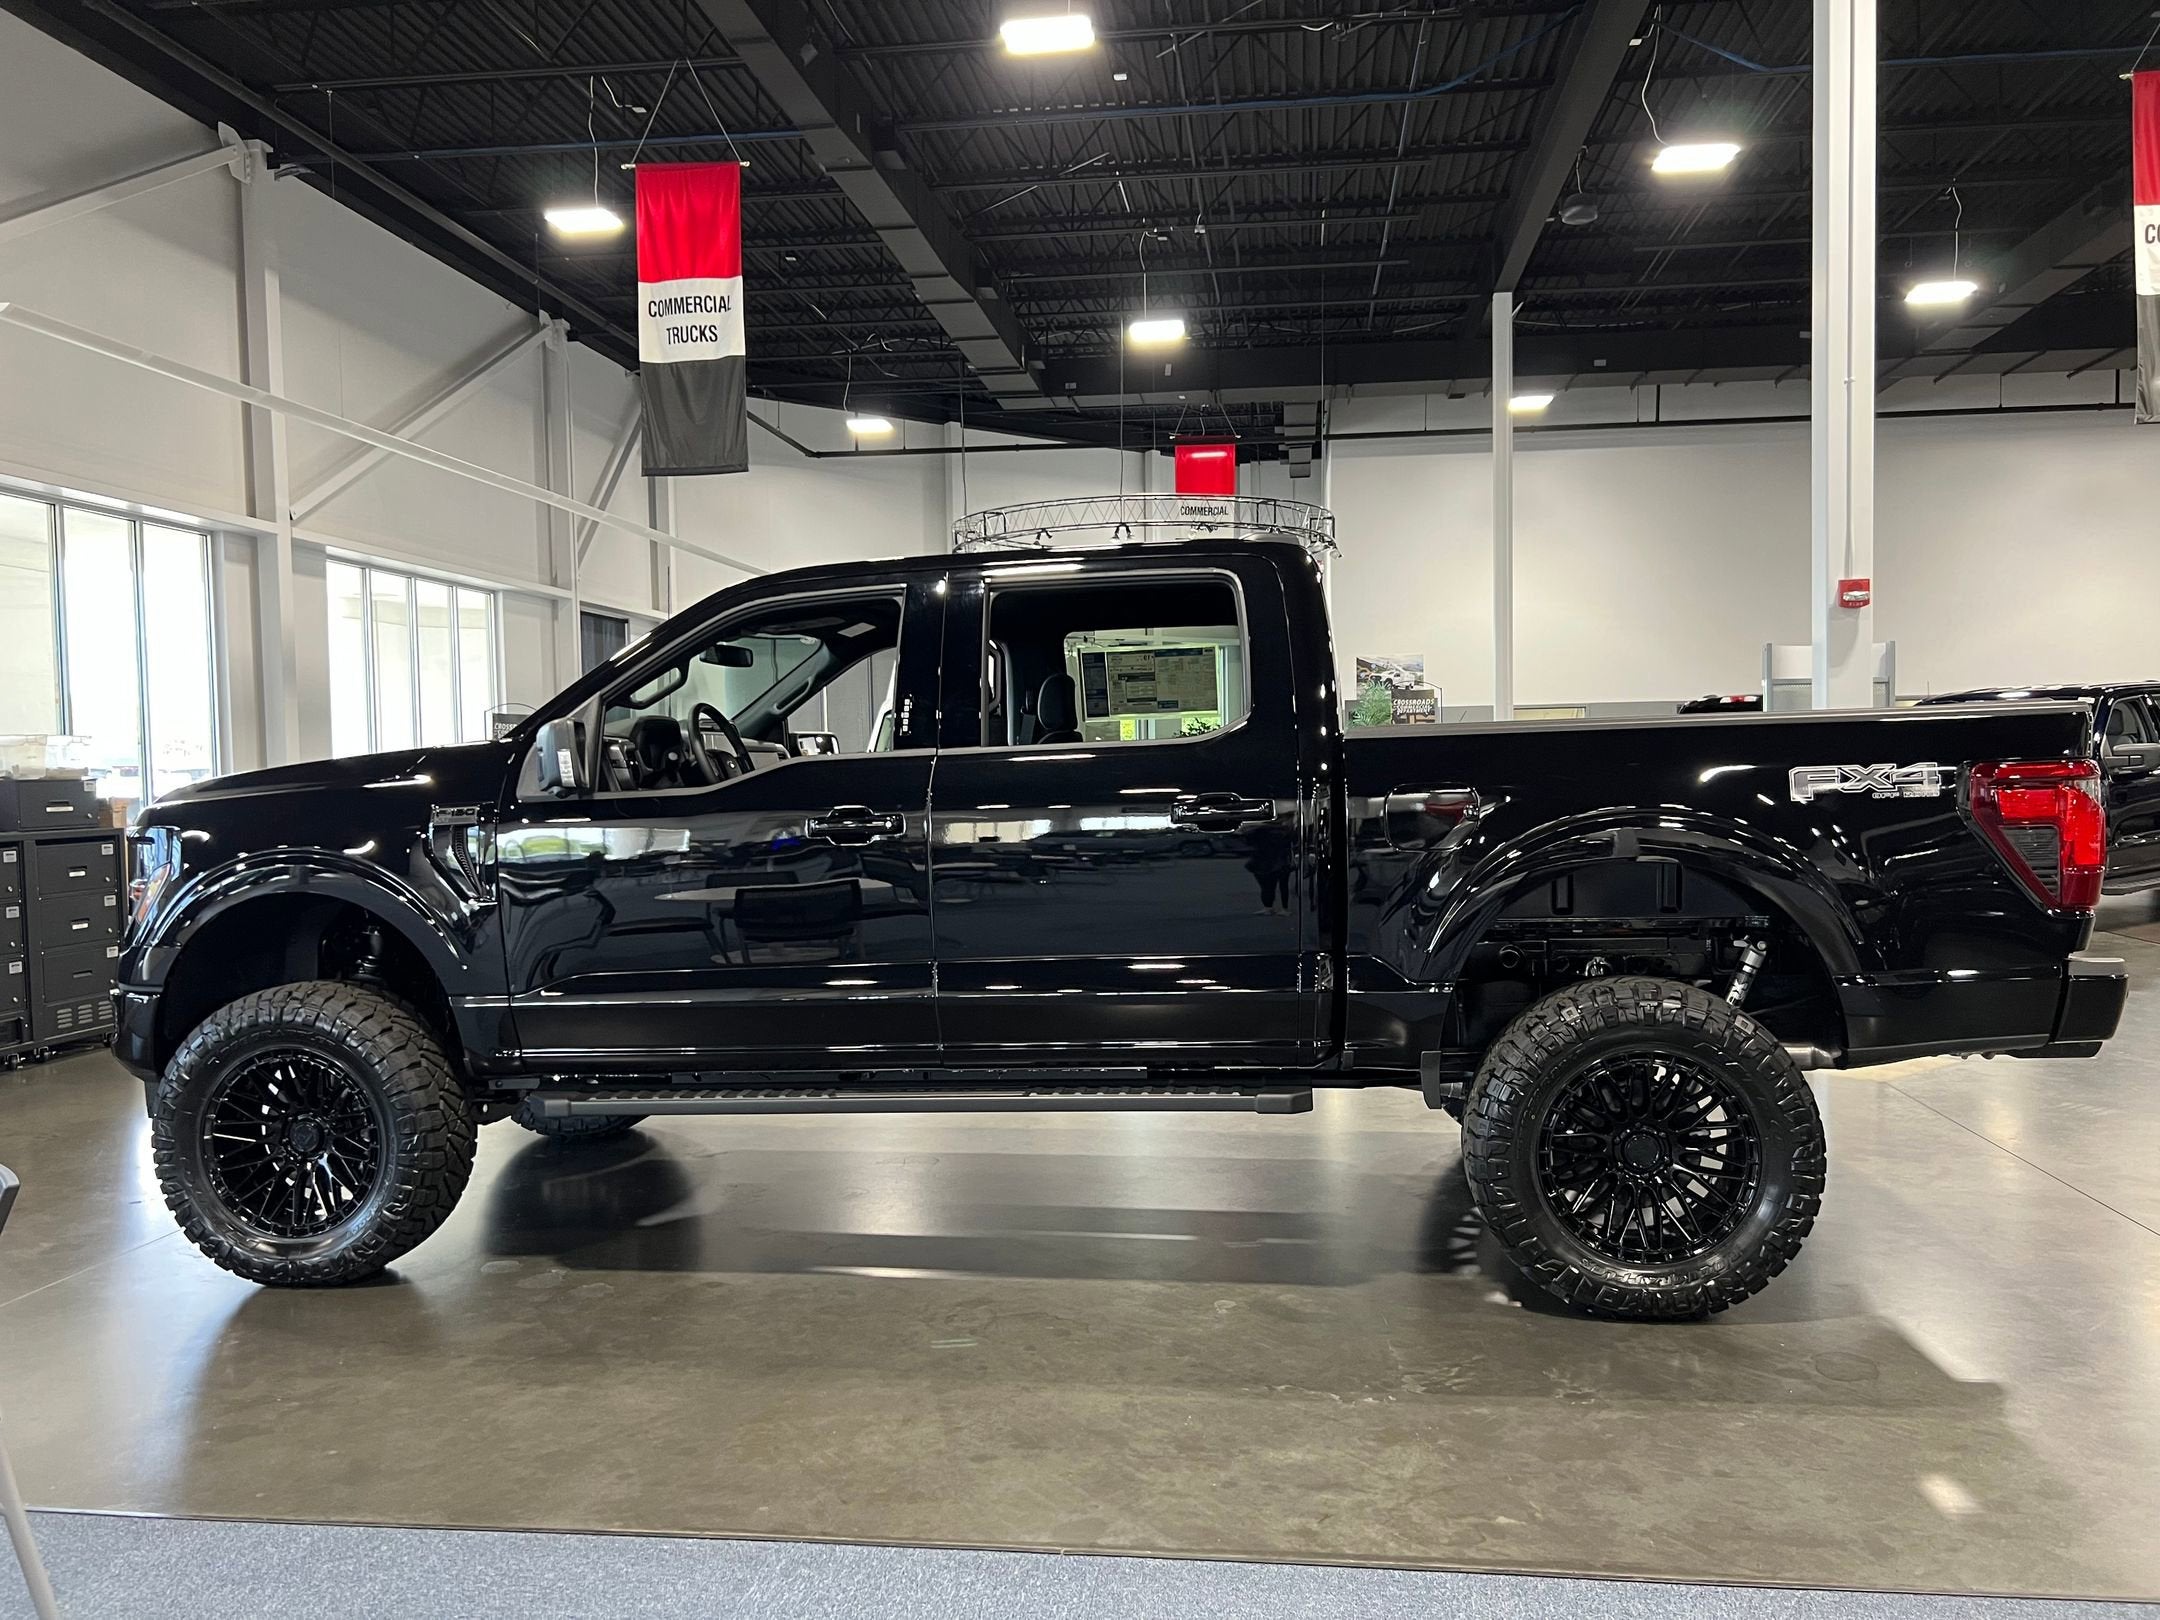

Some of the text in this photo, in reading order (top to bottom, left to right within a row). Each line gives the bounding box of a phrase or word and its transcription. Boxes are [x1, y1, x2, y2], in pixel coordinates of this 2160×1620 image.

[648, 295, 731, 318] COMMERCIAL
[666, 325, 718, 345] TRUCKS
[1180, 505, 1229, 516] COMMERCIAL
[1788, 762, 1942, 801] FX4
